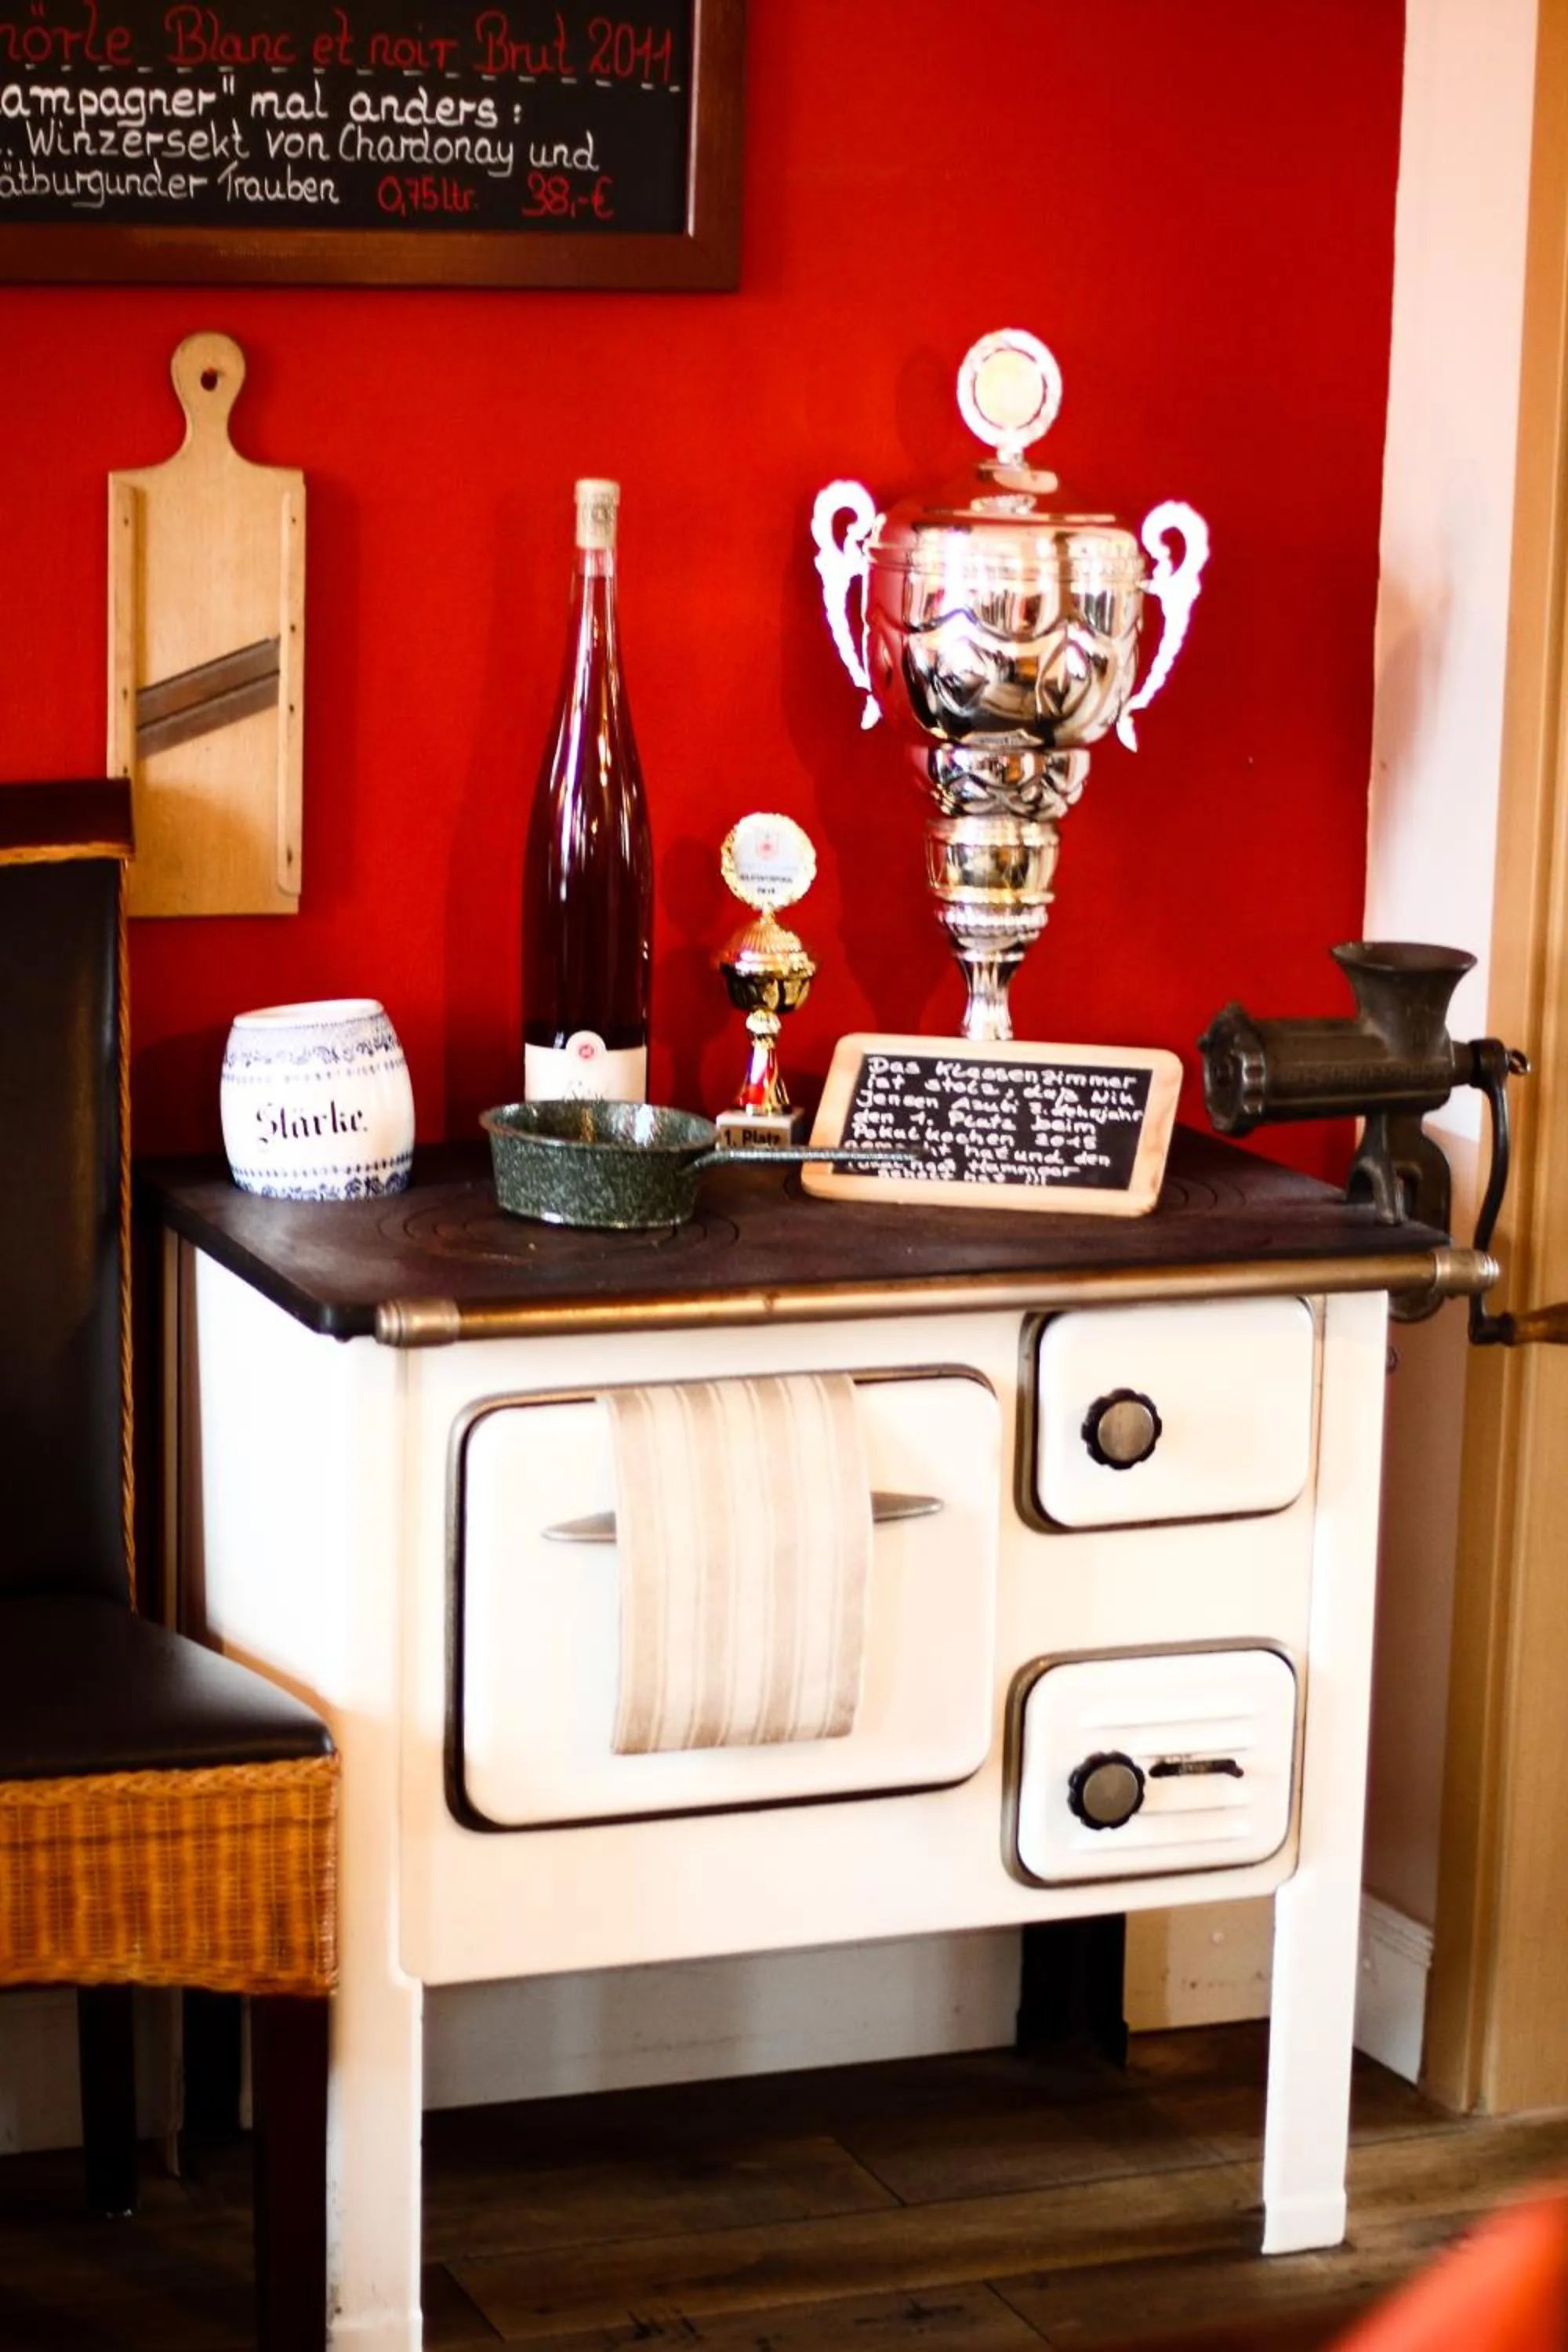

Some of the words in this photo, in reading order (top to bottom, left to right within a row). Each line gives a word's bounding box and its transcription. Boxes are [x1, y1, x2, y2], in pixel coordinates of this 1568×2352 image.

[164, 5, 296, 65] Blanc
[313, 9, 351, 66] et
[474, 9, 575, 73] Brut
[588, 17, 673, 83] 2011
[0, 74, 235, 131] ampagner"
[249, 80, 329, 119] mal
[266, 128, 330, 162] von
[339, 122, 514, 177] Chardonay
[529, 131, 599, 172] und
[217, 162, 340, 204] Trauben
[867, 1073, 905, 1091] ist
[868, 1057, 920, 1075] Das
[935, 1061, 1137, 1089] Klassenzimmer
[853, 1109, 895, 1125] den
[909, 1111, 934, 1127] 1.
[948, 1109, 1017, 1132] Platz
[1030, 1114, 1096, 1136] beim
[964, 1144, 1010, 1161] hat
[1014, 1149, 1065, 1166] und
[1073, 1150, 1112, 1167] den
